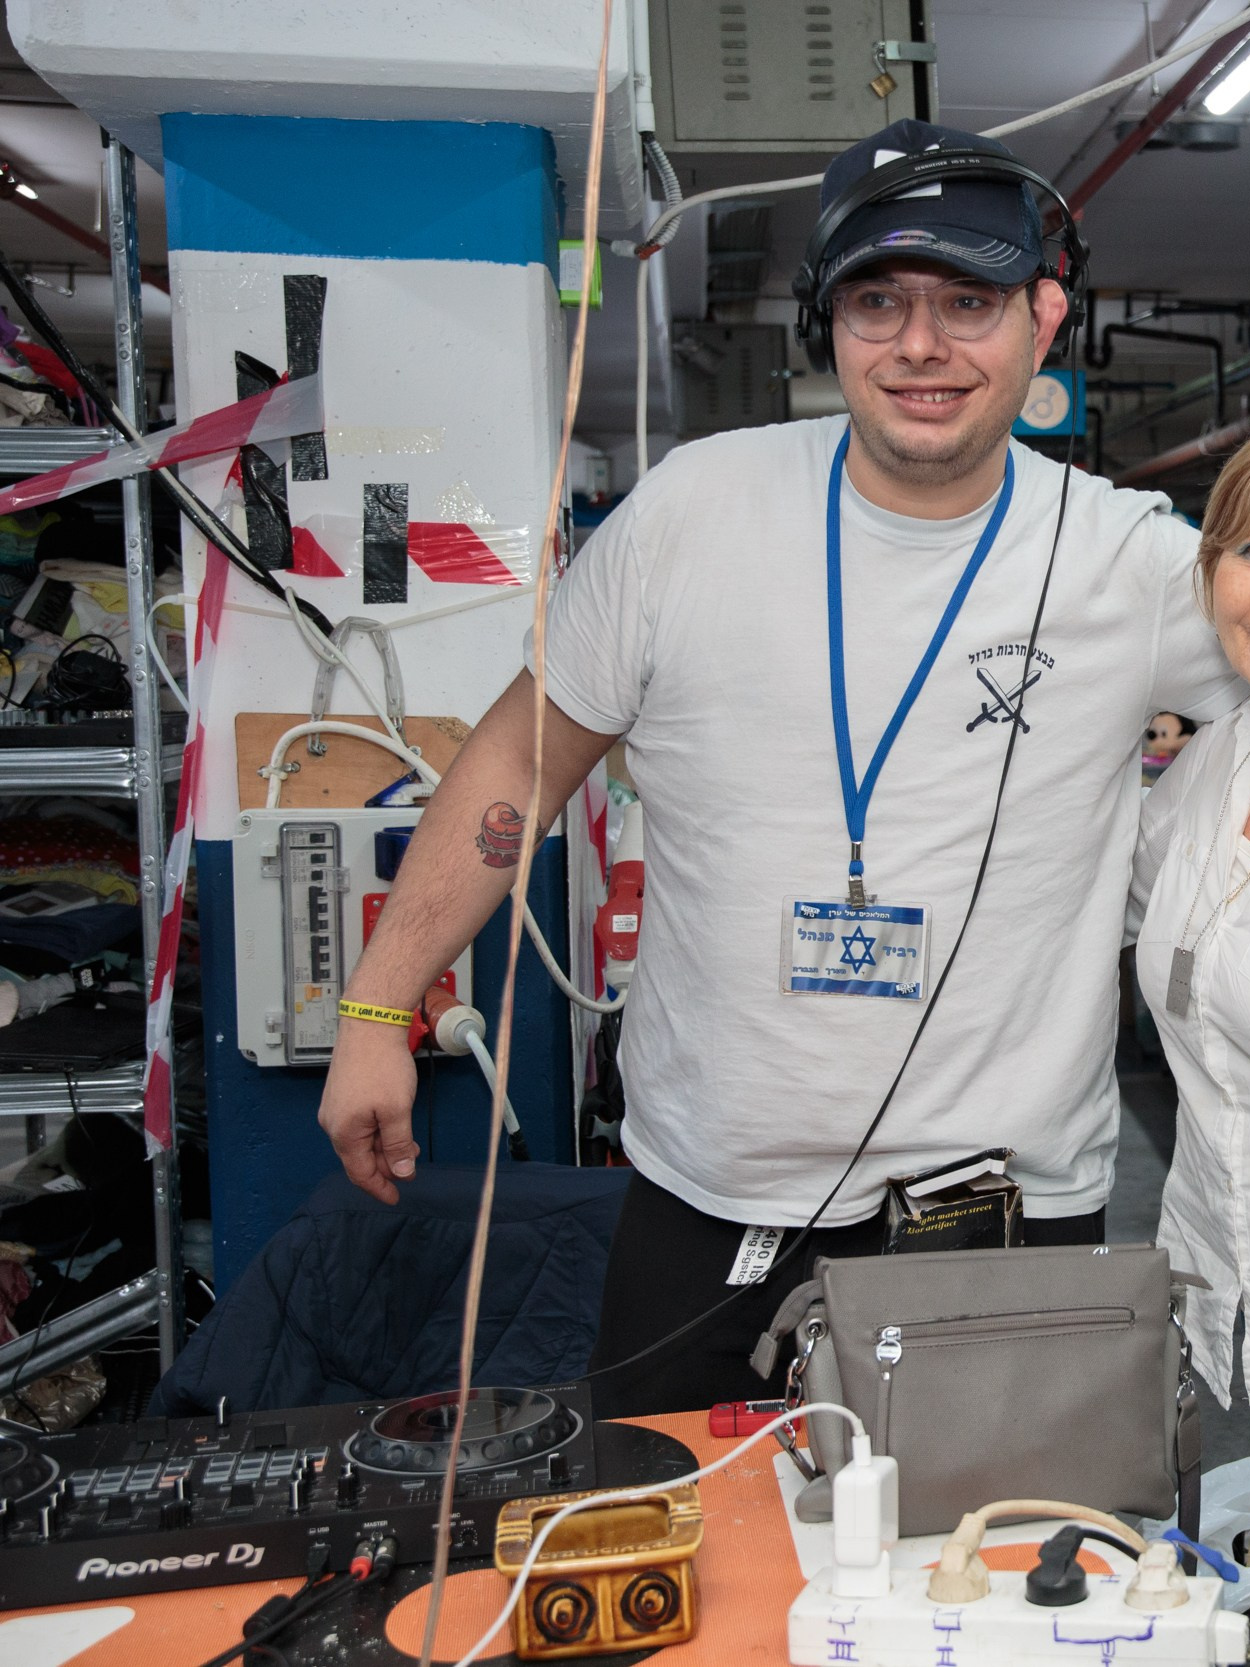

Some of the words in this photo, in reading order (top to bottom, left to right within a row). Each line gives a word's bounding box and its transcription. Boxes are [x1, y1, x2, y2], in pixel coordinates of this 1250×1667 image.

[968, 648, 993, 664] ברזל
[996, 644, 1027, 656] חרבות
[828, 909, 842, 918] ערן
[844, 909, 856, 917] של
[858, 910, 891, 919] המלאכים
[797, 927, 836, 943] מנהל
[882, 945, 918, 959] רביד
[937, 1208, 967, 1220] market
[968, 1203, 992, 1214] street
[925, 1219, 957, 1232] artifact
[757, 1229, 778, 1260] 400
[317, 1526, 330, 1534] USB
[363, 1520, 388, 1529] MASTER
[76, 1551, 220, 1582] Pioneer
